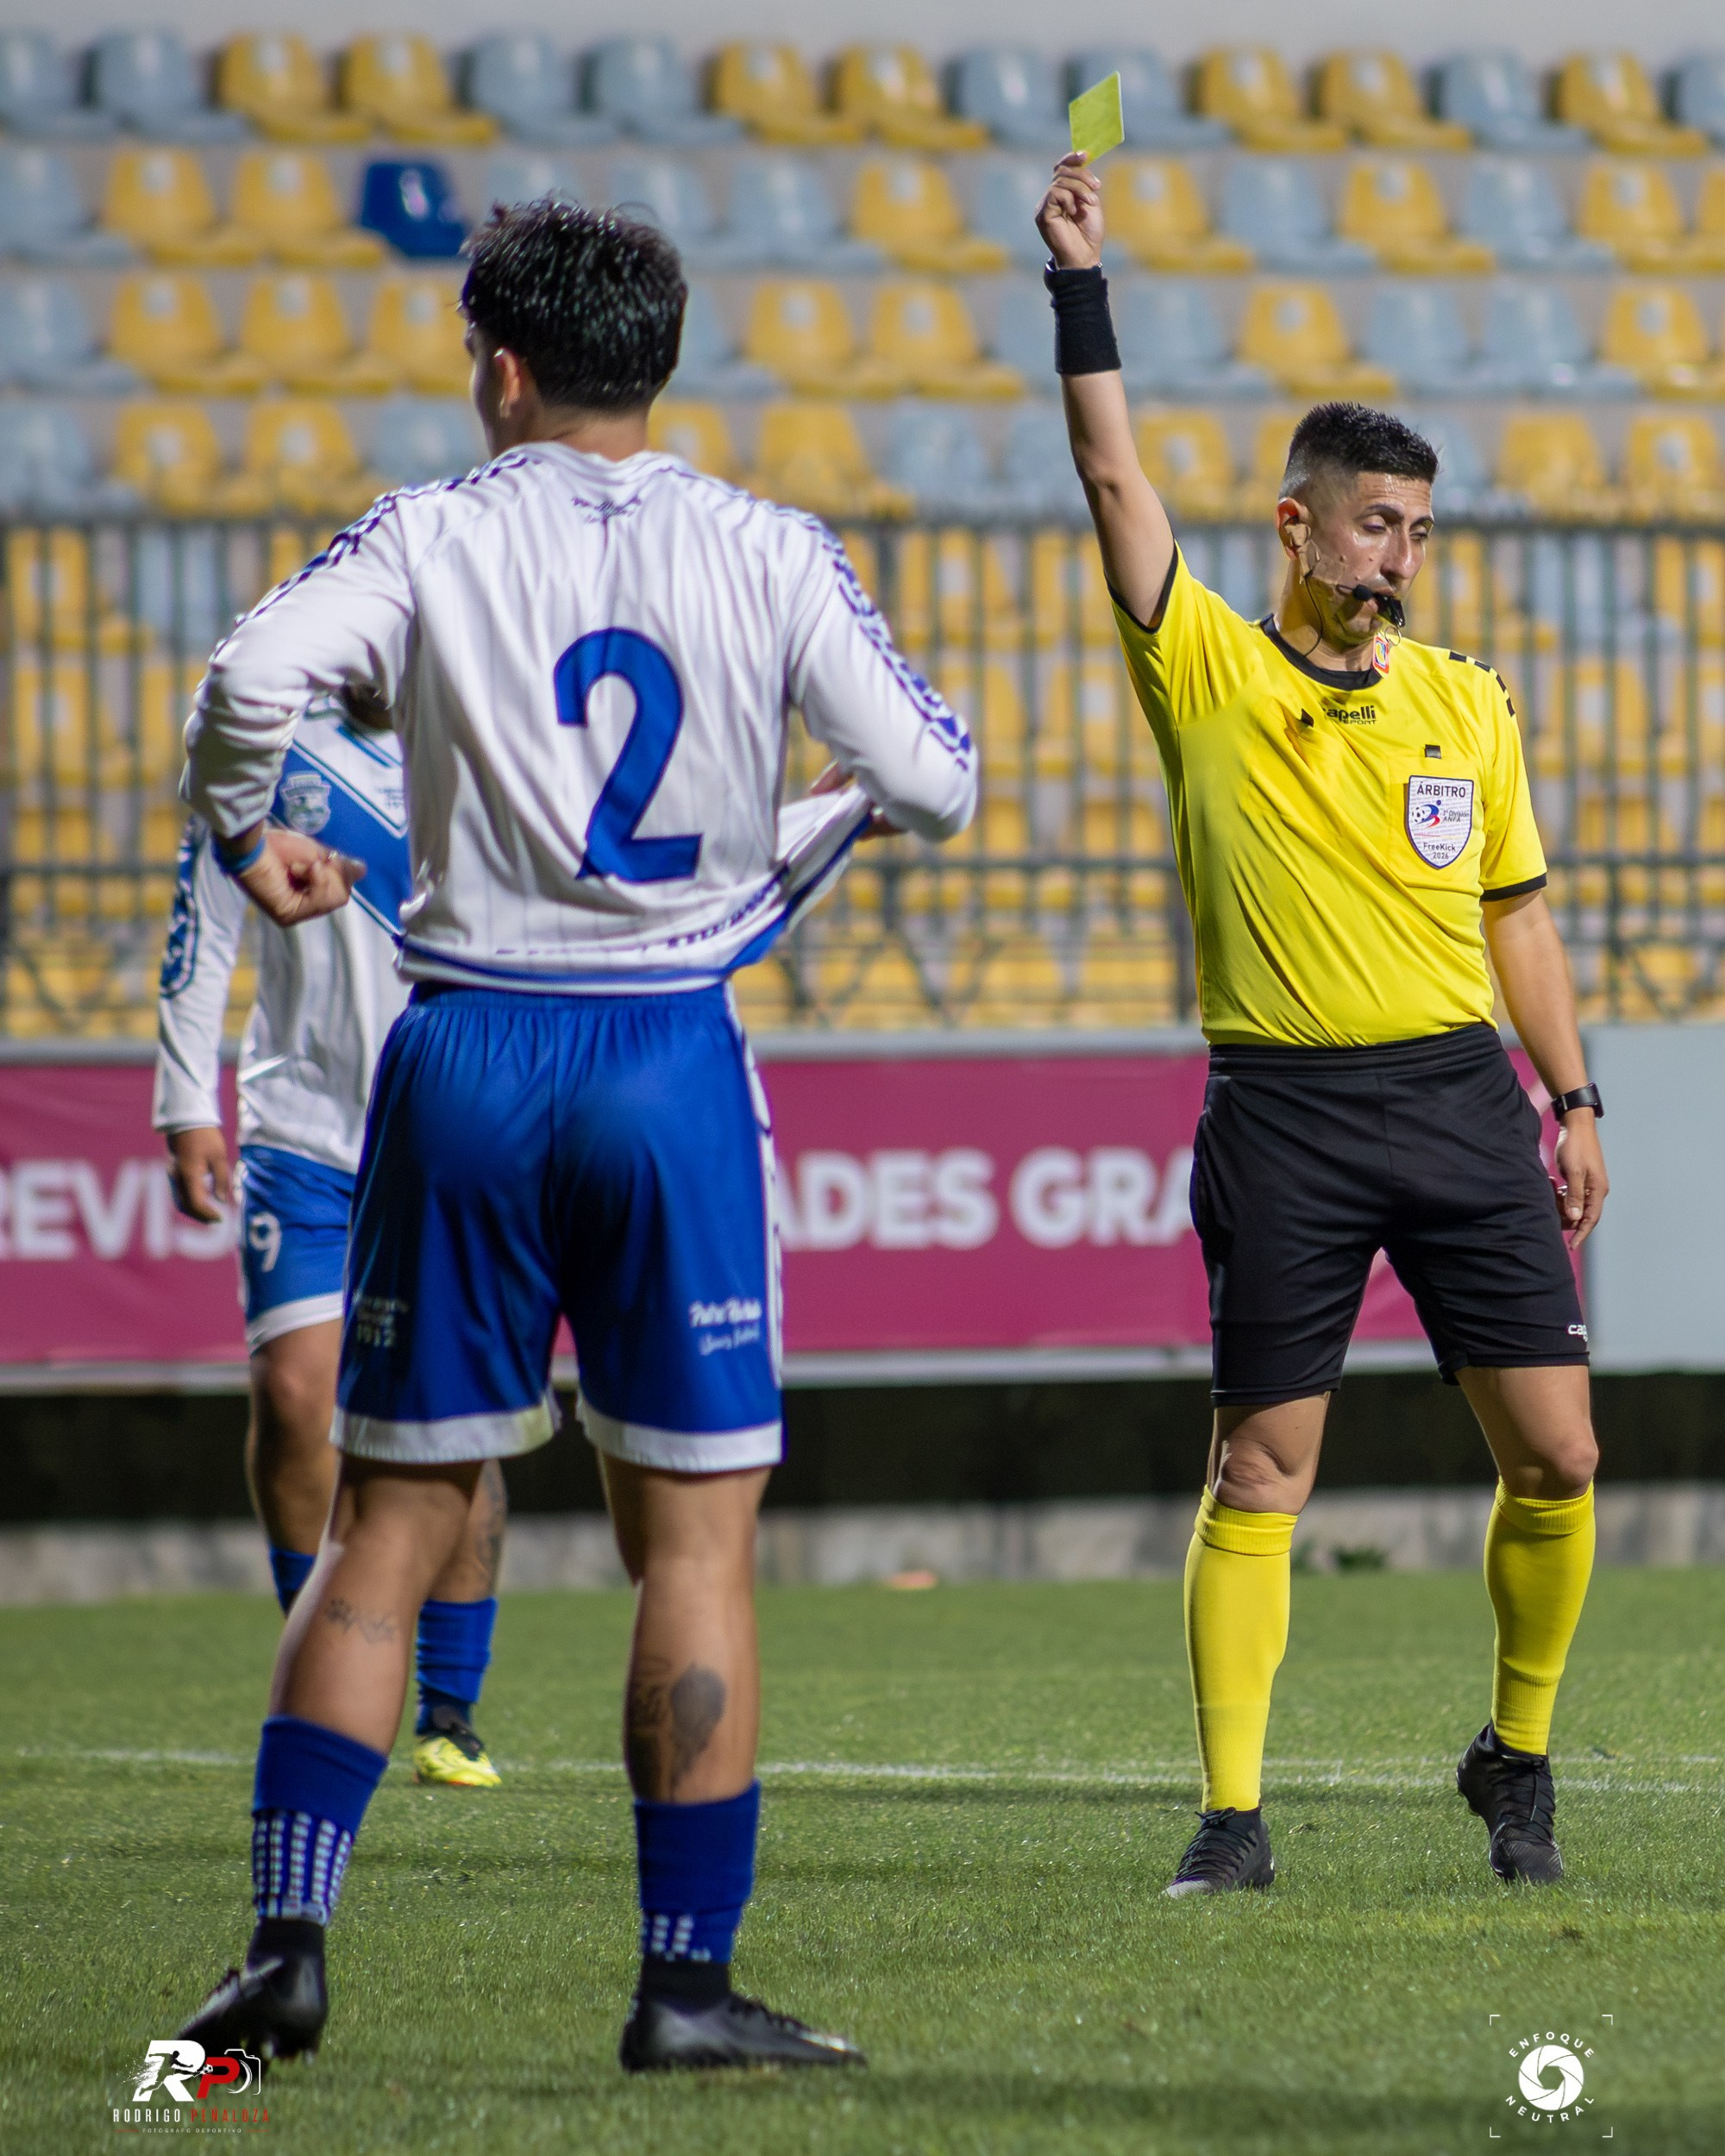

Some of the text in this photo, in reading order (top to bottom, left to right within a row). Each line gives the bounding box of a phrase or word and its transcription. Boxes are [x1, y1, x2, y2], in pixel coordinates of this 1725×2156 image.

[1321, 705, 1377, 722] apelli
[554, 627, 703, 882] 2
[1417, 780, 1466, 798] ÁRBITRO
[1423, 842, 1456, 851] FreeKick
[249, 1212, 283, 1273] 9
